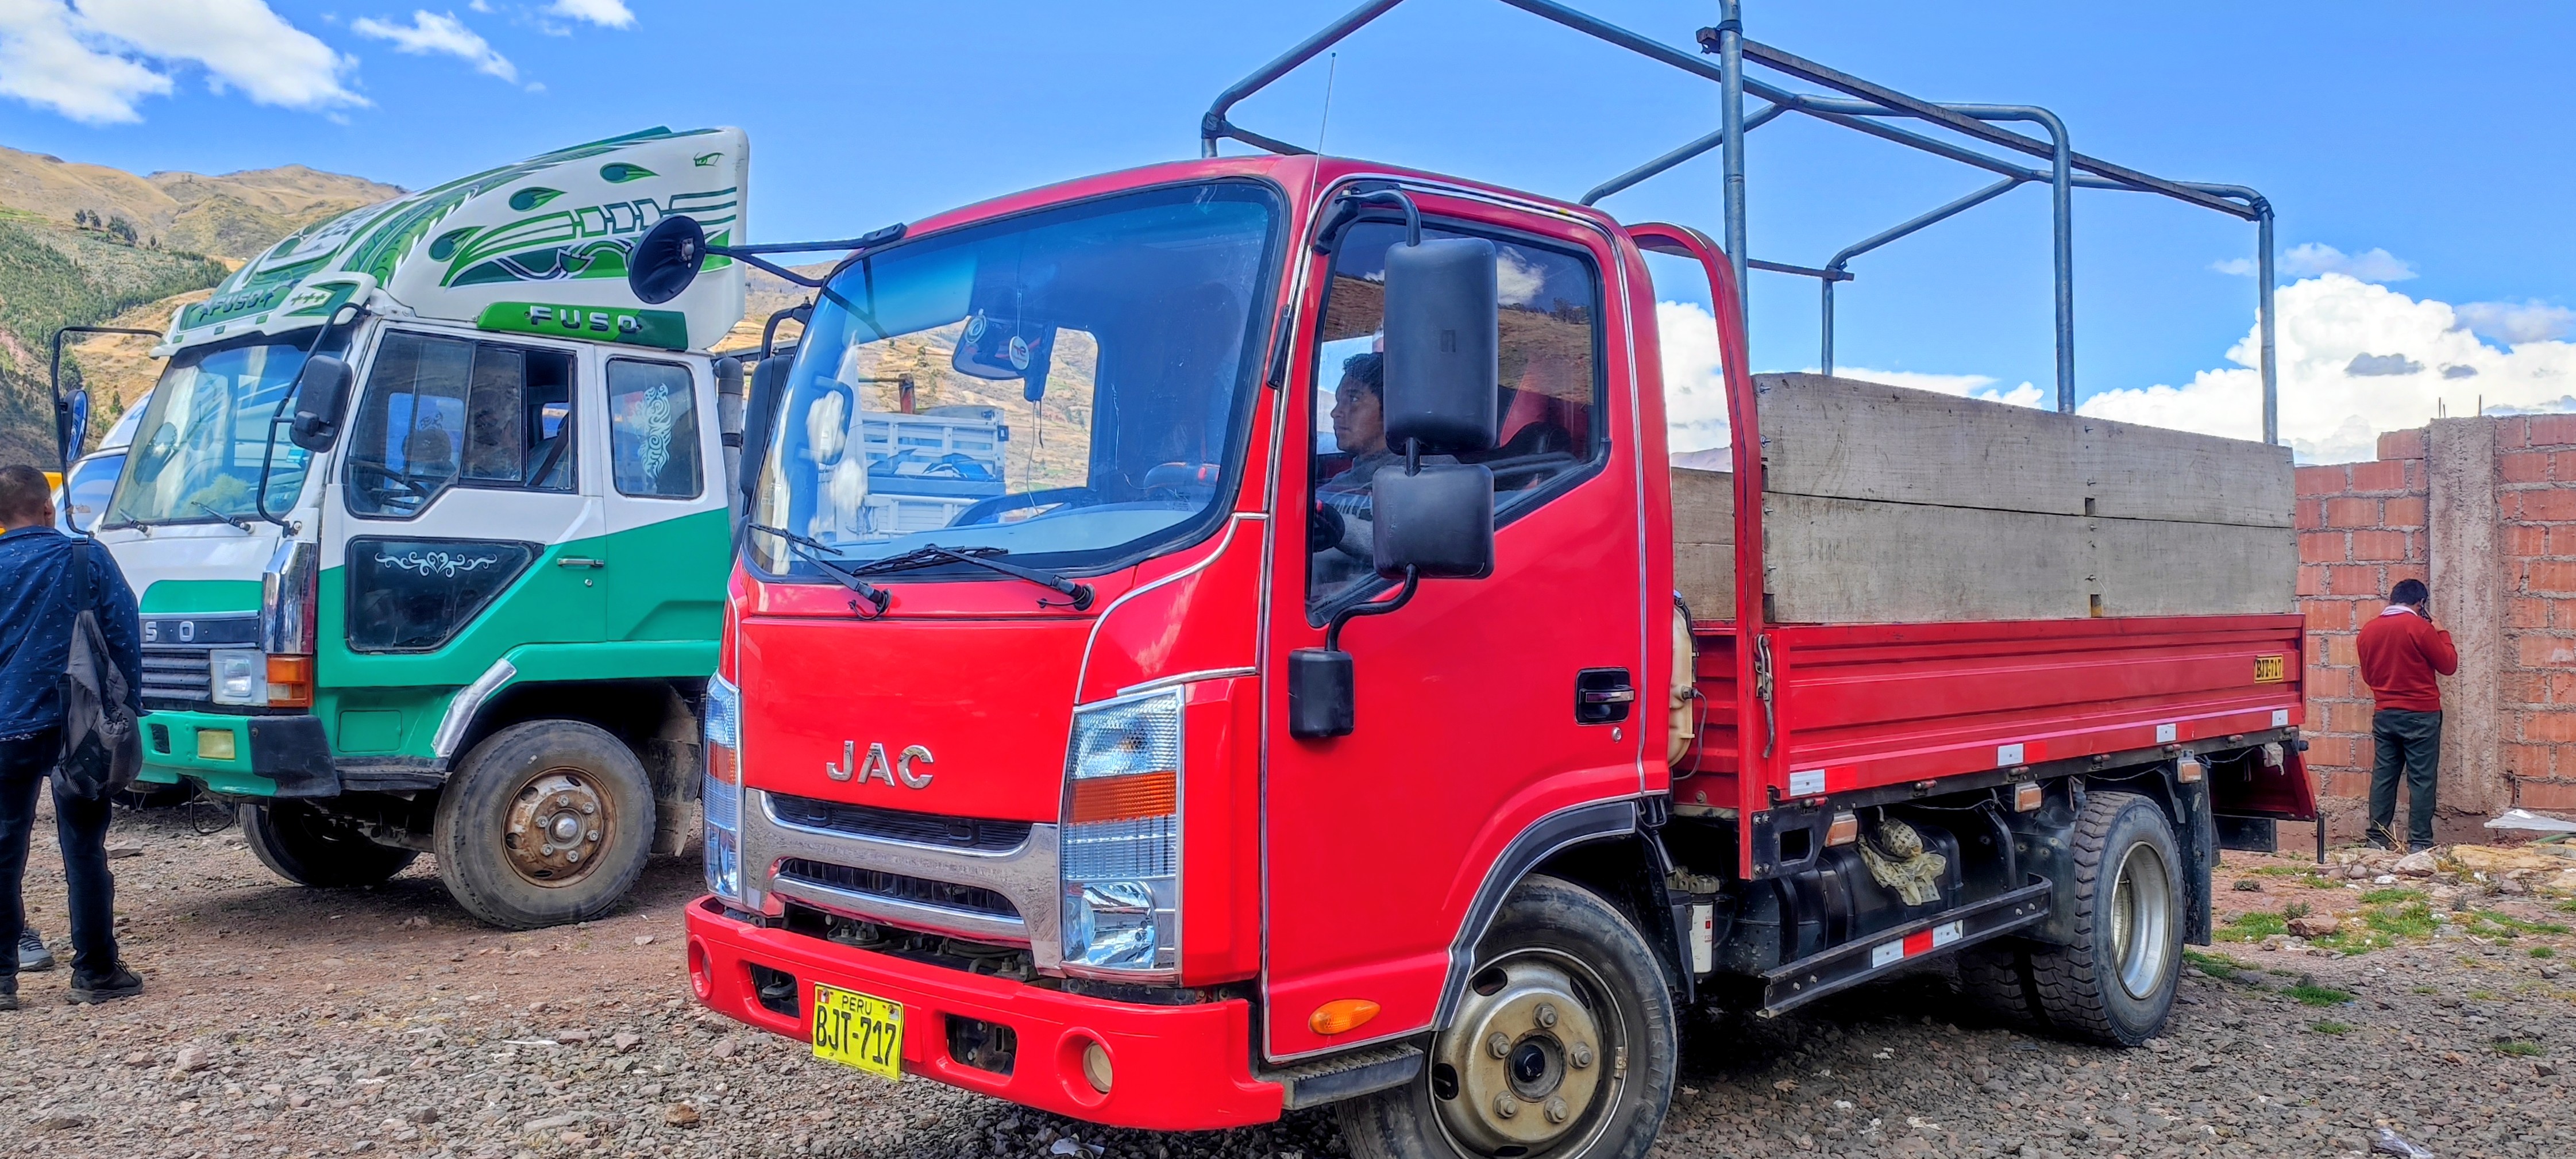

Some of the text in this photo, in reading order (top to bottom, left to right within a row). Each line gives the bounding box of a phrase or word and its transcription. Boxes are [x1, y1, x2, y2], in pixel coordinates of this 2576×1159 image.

[208, 288, 264, 316] FUSO
[530, 305, 637, 333] FUSO
[145, 621, 195, 642] SO
[2257, 659, 2281, 678] BJT-717
[826, 740, 934, 790] JAC
[842, 995, 872, 1015] PERU
[816, 1005, 896, 1066] BJT-717
